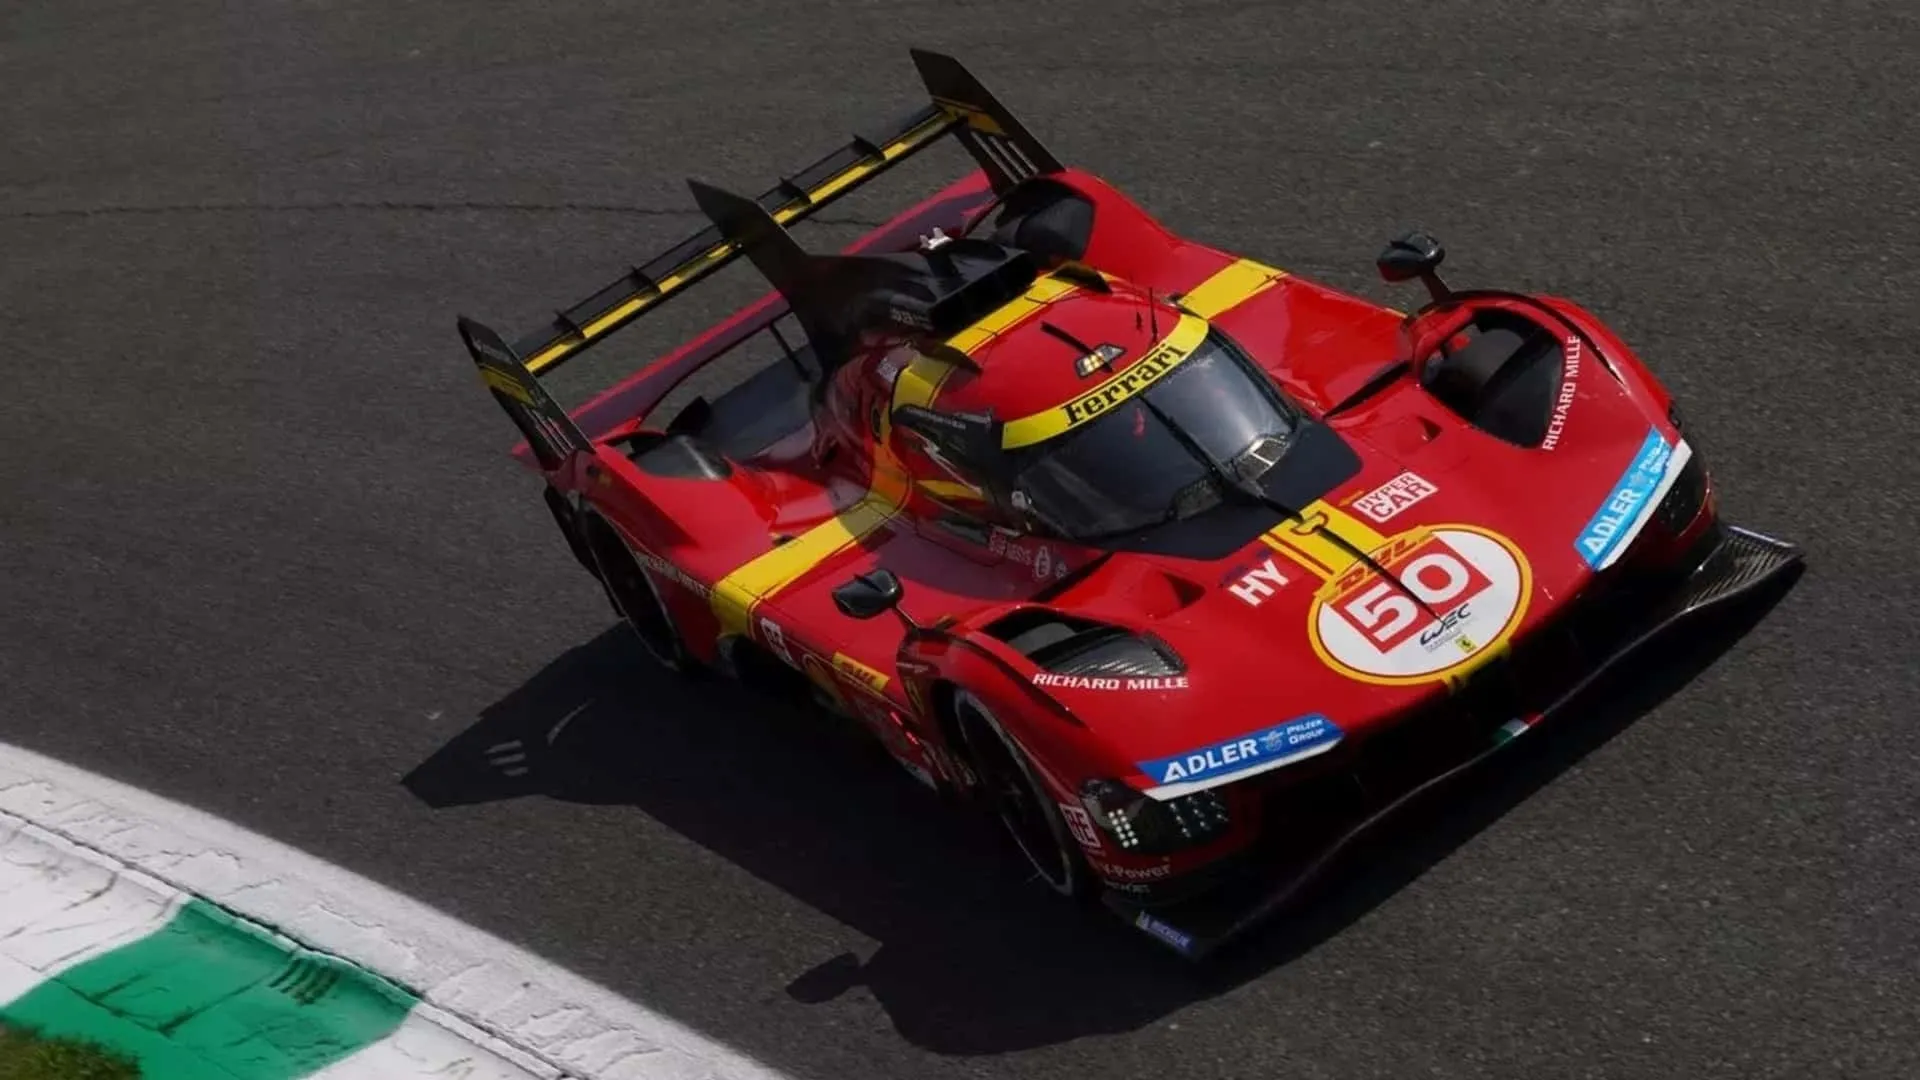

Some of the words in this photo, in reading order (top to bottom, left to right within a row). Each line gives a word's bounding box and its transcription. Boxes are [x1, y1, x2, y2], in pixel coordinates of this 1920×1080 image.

[1061, 342, 1188, 427] Ferrari
[1542, 382, 1577, 451] RICHARD
[1565, 335, 1581, 378] MILLE
[1358, 475, 1416, 510] HYPER
[1370, 481, 1432, 518] CAR
[1583, 488, 1643, 555] ADLER
[1228, 558, 1290, 607] HY
[1343, 552, 1470, 643] 50
[1419, 602, 1472, 646] WEC
[1032, 672, 1121, 691] RICHARD
[1127, 676, 1189, 691] MILLE
[1286, 718, 1324, 736] PELZER
[1288, 728, 1326, 746] GROUP
[1163, 738, 1259, 784] ADLER
